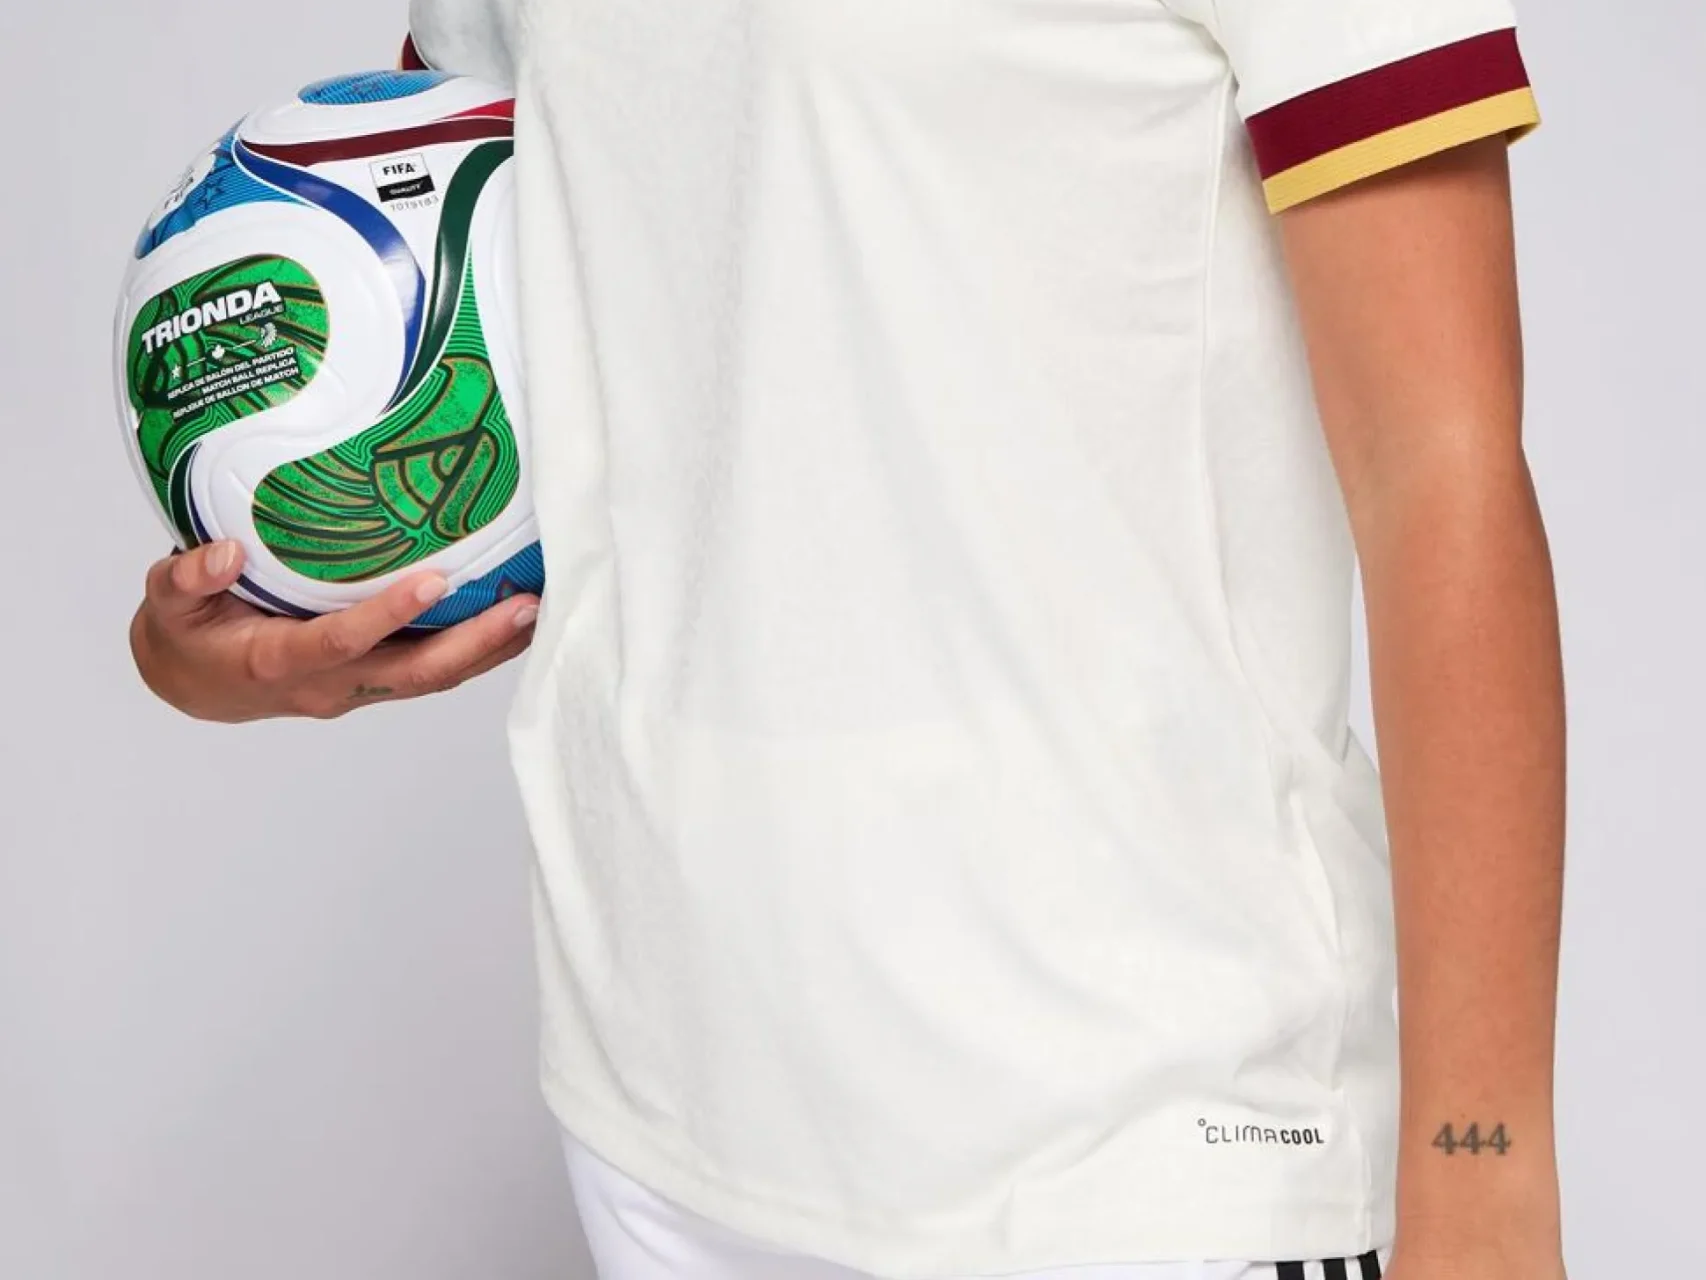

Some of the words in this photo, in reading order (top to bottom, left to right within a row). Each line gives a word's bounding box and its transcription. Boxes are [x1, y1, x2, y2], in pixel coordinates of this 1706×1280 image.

[382, 162, 416, 176] FIFA
[141, 281, 282, 354] TRIONDA
[239, 304, 284, 325] LEAGUE
[251, 346, 294, 365] PARTIDO
[202, 379, 231, 394] MATCH
[231, 371, 254, 383] BALL
[264, 366, 299, 383] MATCH
[1431, 1120, 1512, 1157] 444
